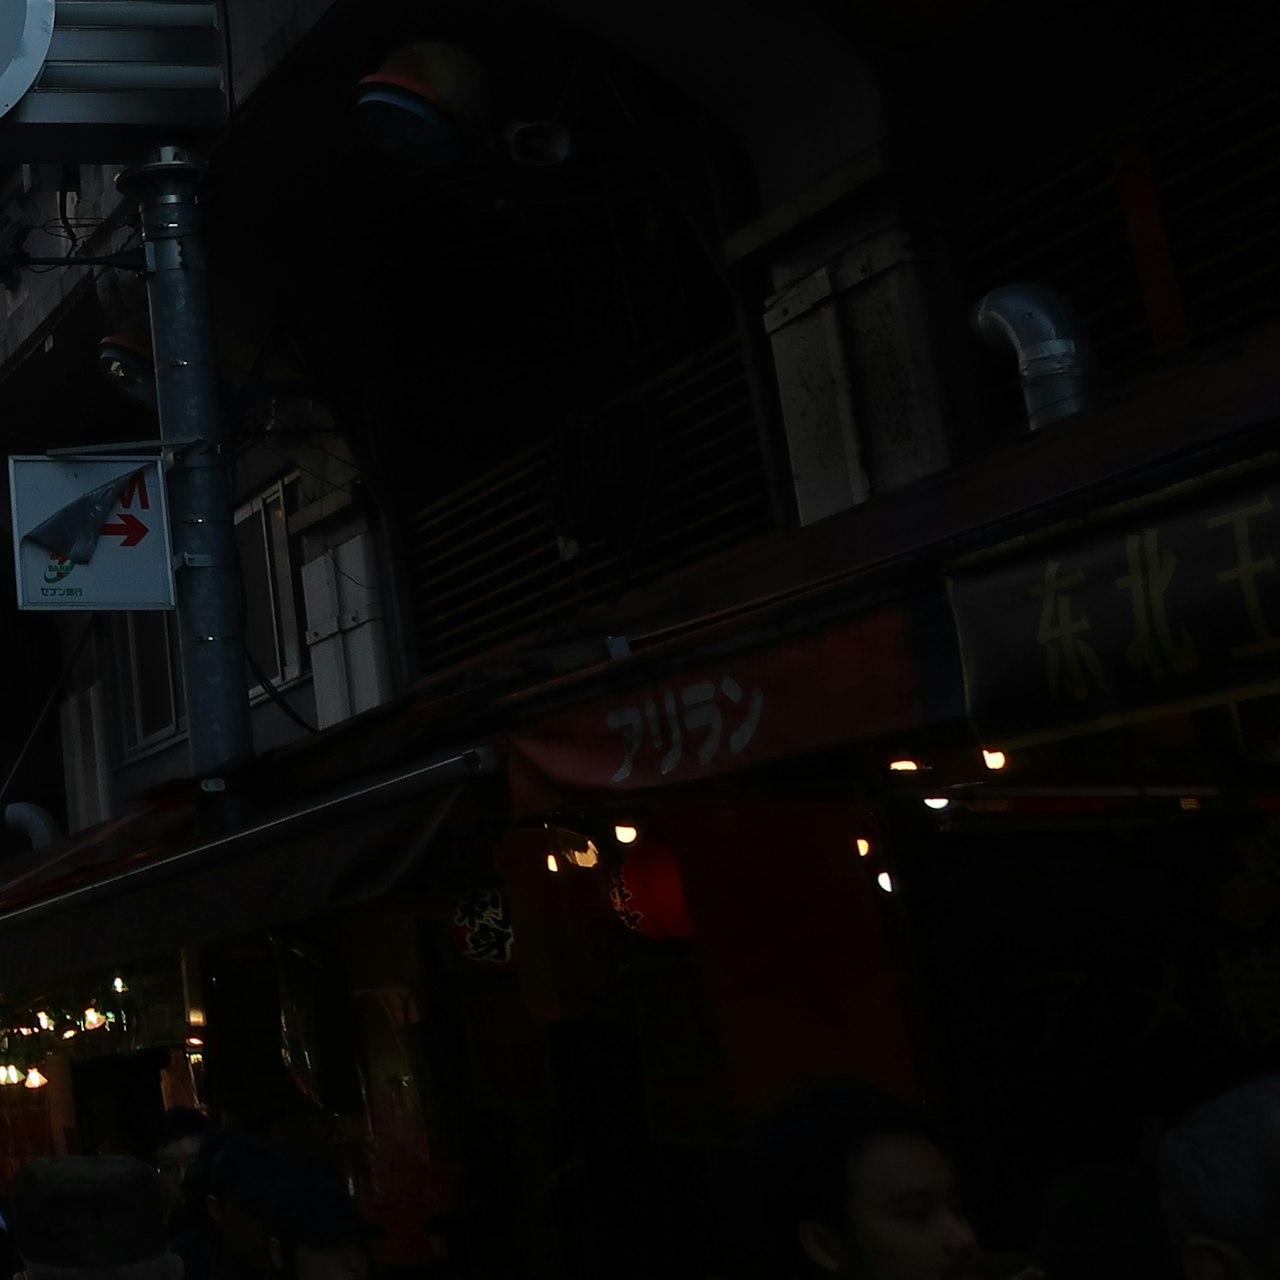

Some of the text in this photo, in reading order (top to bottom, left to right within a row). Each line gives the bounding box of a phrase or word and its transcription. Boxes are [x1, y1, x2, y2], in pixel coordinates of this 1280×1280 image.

[40, 586, 83, 597] セブン銀行
[608, 673, 764, 783] アリラン
